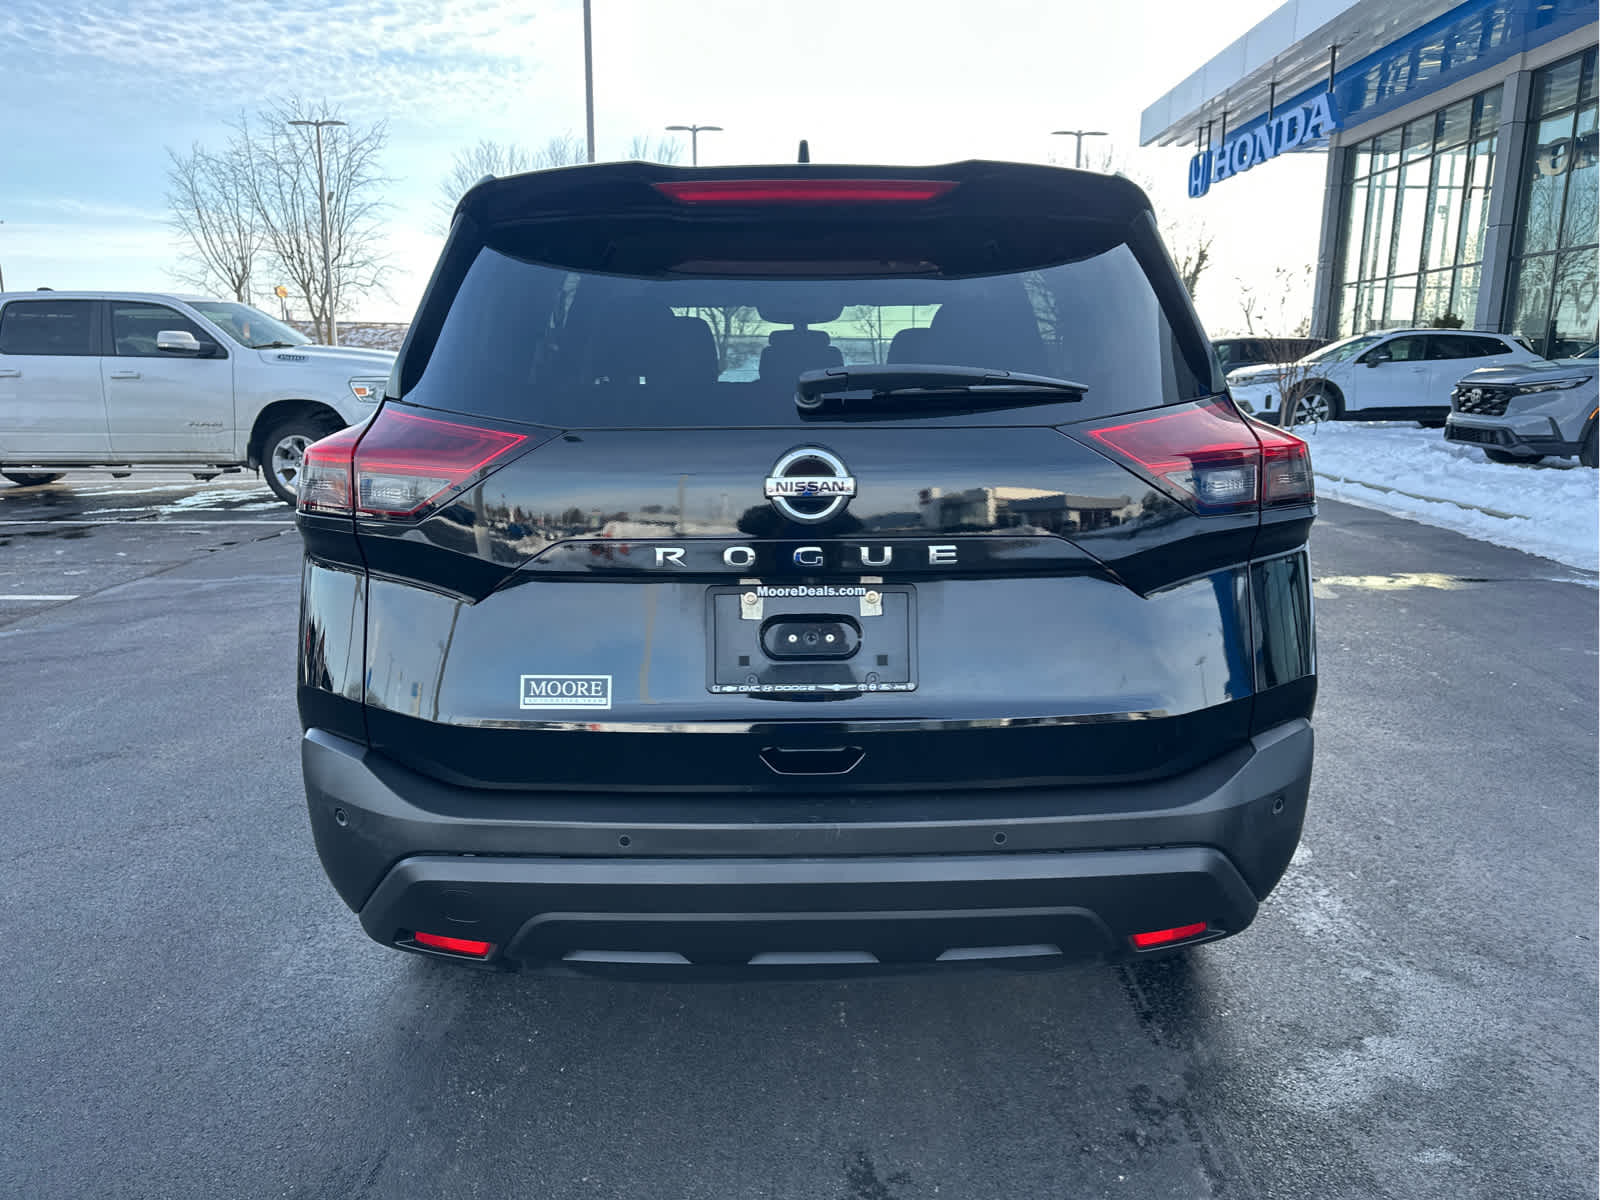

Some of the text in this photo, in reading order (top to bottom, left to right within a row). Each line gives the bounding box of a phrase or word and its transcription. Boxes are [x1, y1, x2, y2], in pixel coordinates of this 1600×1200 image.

[1210, 92, 1337, 183] HONDA
[775, 480, 845, 493] NISSAN
[655, 544, 958, 567] ROGUE
[756, 585, 867, 598] MooreDeals.com
[528, 680, 603, 696] MOORE
